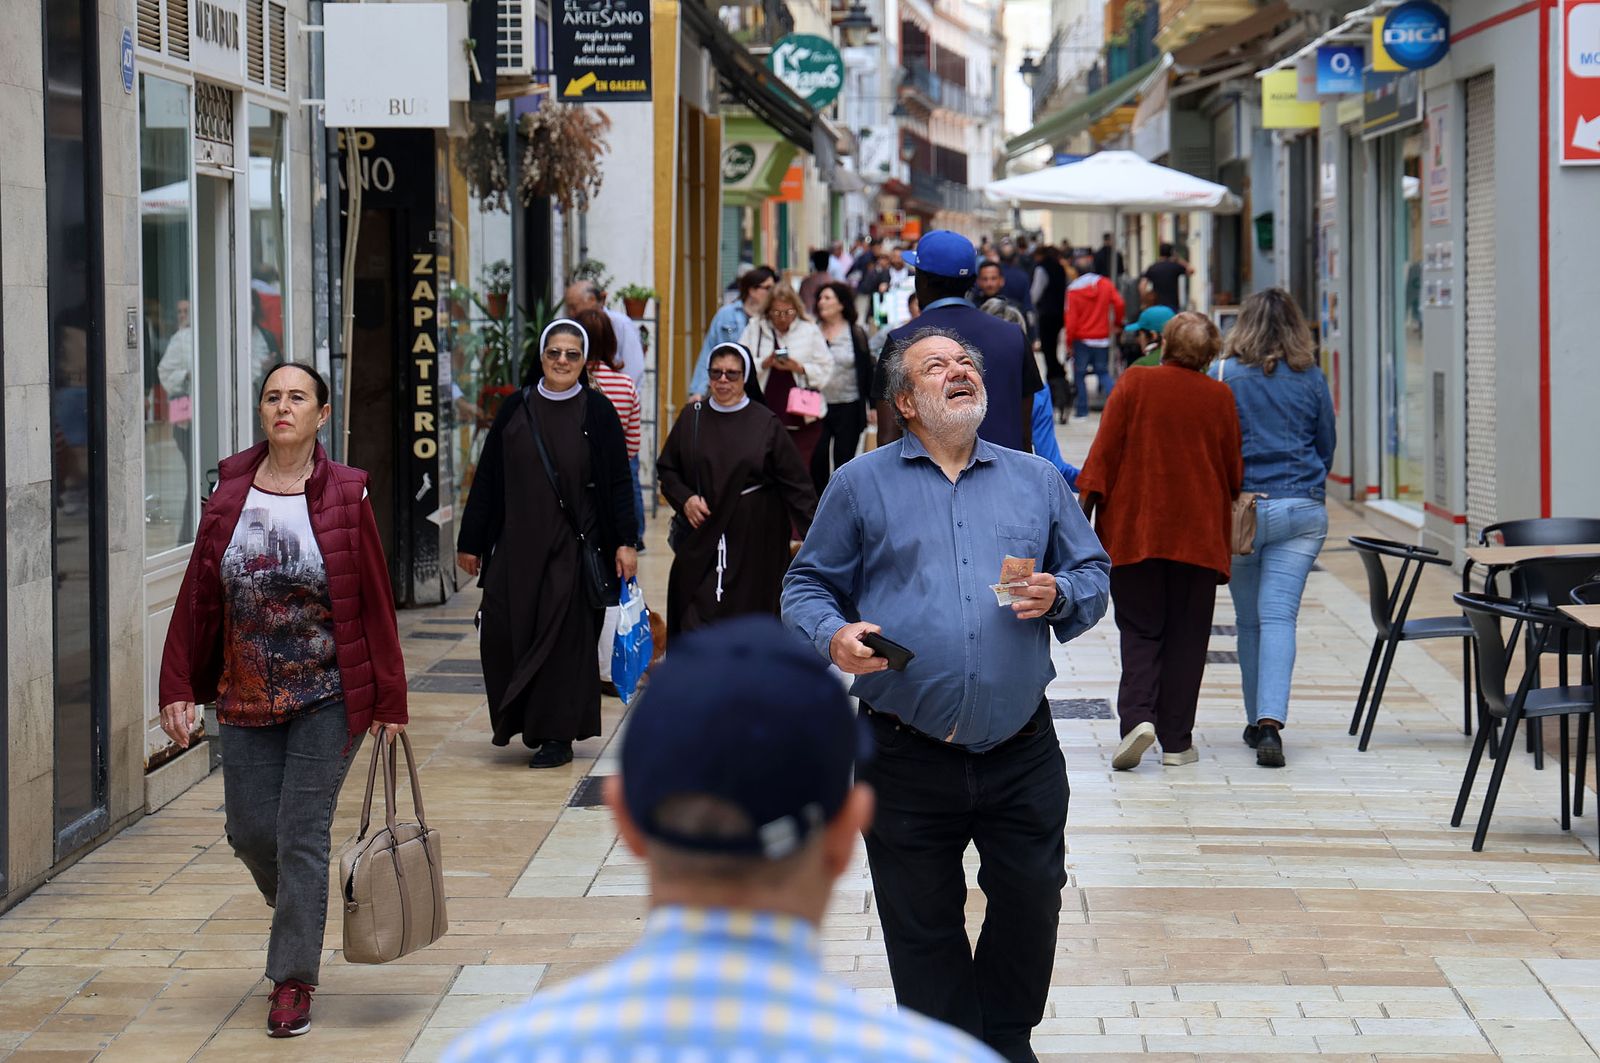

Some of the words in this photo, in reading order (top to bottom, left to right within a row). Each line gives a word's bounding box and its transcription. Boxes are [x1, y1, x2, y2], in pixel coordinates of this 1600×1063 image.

[563, 0, 581, 11] EL
[562, 9, 644, 27] ARTESANO
[574, 30, 603, 42] Arreglo
[611, 31, 633, 41] venta
[1384, 28, 1446, 44] DIGI
[582, 42, 596, 53] del
[607, 58, 618, 66] en
[619, 55, 635, 67] piel
[595, 80, 608, 92] EN
[411, 253, 437, 460] ZAPATERO
